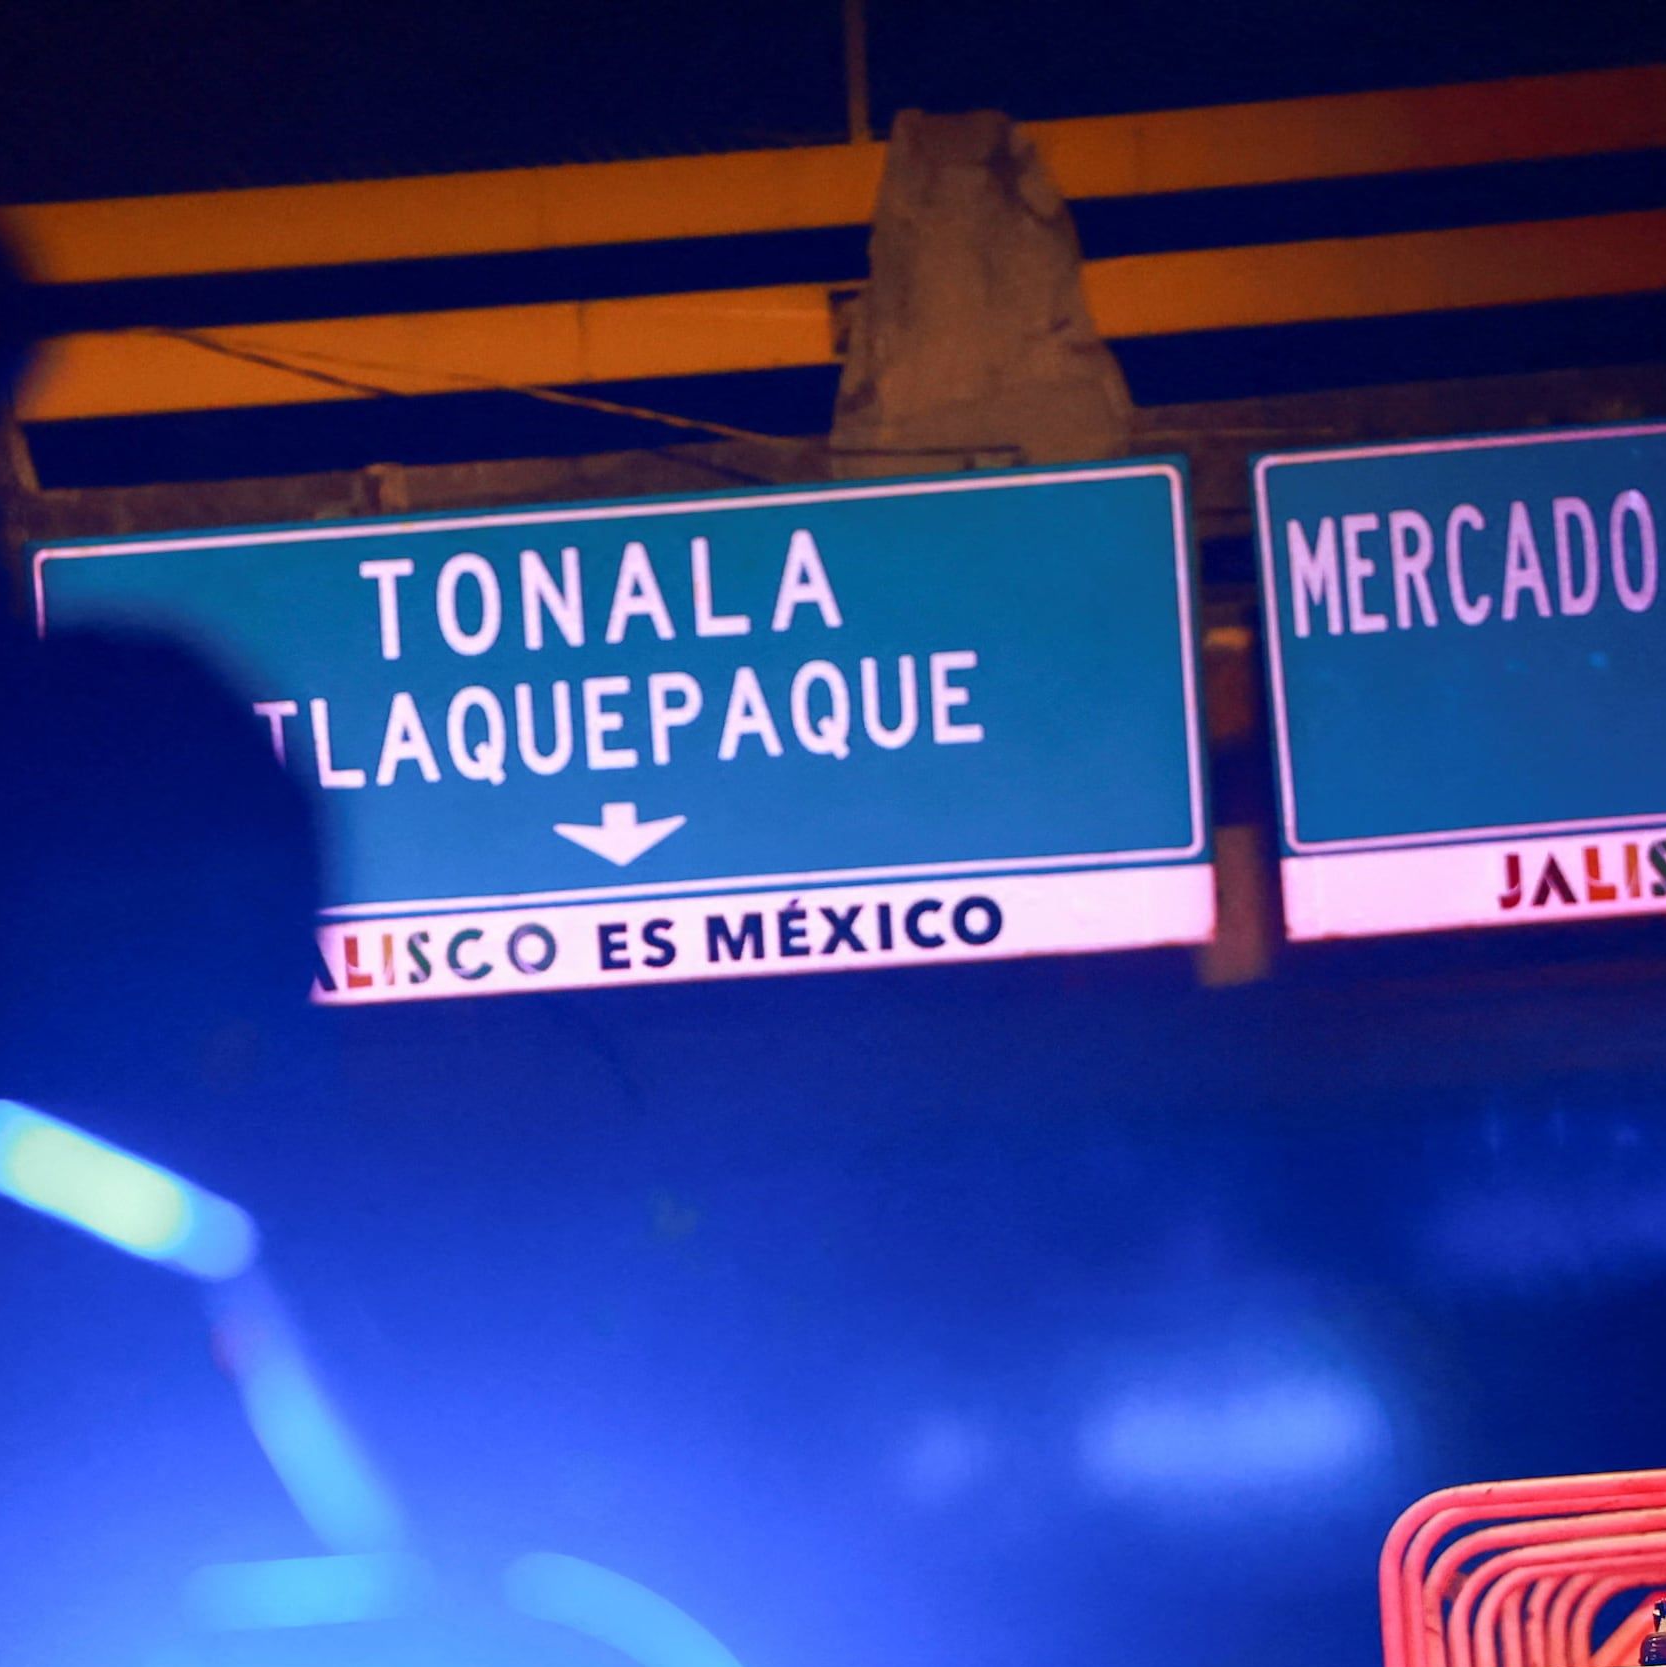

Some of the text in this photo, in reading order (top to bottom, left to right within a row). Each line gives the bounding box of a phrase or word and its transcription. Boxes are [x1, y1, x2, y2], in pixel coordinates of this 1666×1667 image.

[359, 529, 842, 661] TONALA
[1287, 490, 1658, 638] MERCADO
[252, 651, 985, 790] TLAQUEPAQUE
[598, 917, 678, 972] ES
[706, 896, 1005, 962] MÉXICO
